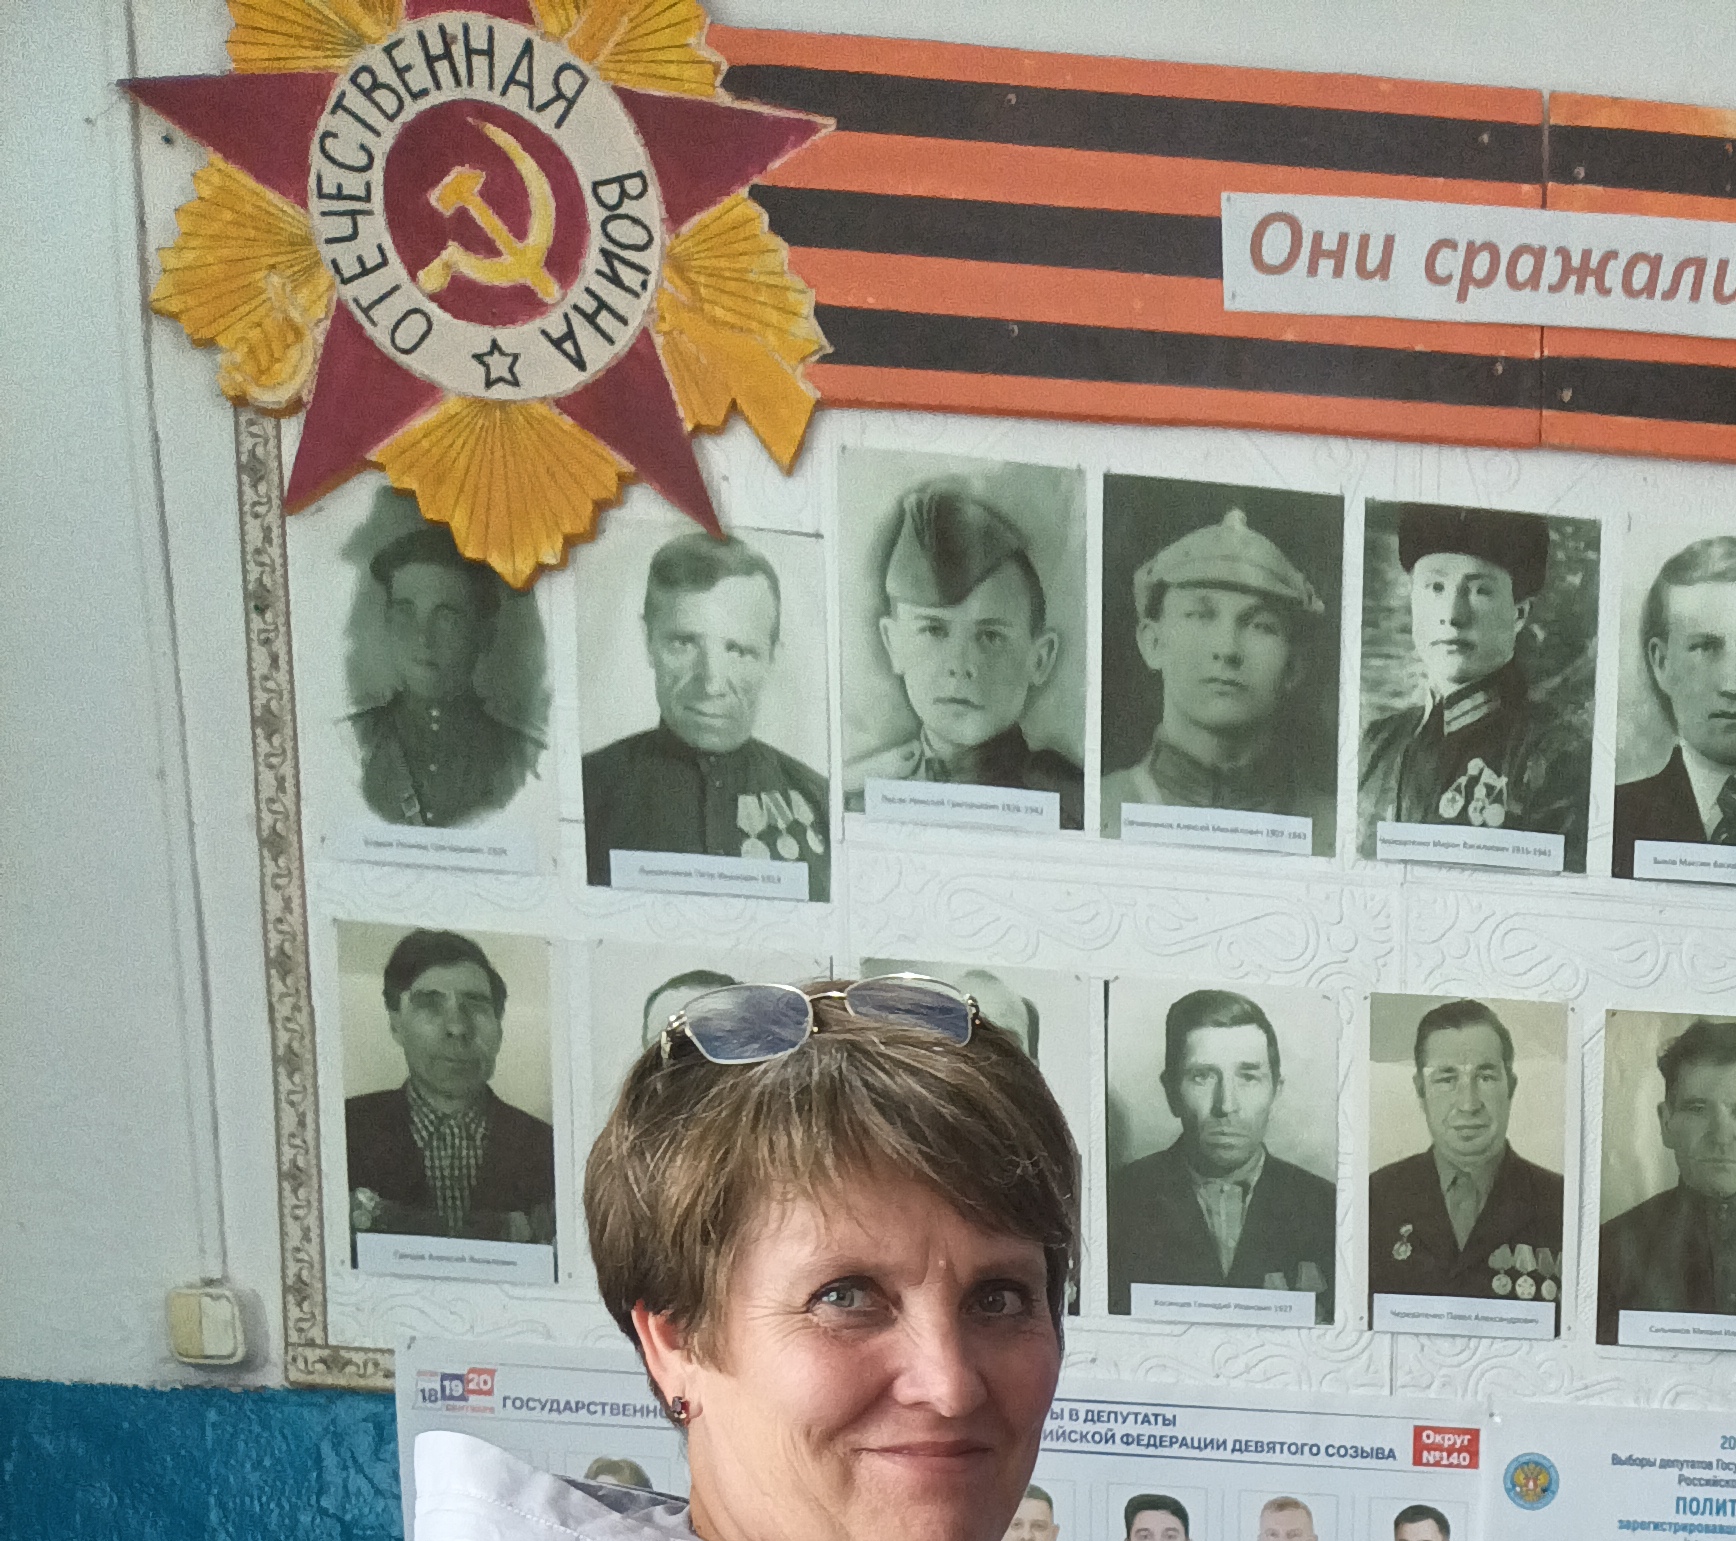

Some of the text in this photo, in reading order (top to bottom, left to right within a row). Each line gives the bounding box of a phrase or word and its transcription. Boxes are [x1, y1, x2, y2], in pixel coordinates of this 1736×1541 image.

[317, 22, 655, 373] ОТЕЧЕСТВЕННАЯ ВОЙНА
[1249, 211, 1396, 282] Они
[442, 1379, 463, 1397] 19
[467, 1373, 492, 1391] 20
[420, 1387, 439, 1403] 18
[1068, 1408, 1080, 1422] В
[1083, 1410, 1177, 1427] ДЕПУТАТЫ
[1043, 1425, 1397, 1461] ИЙСКОЙ ФЕДЕРАЦИИ ДЕВЯТОГО СОЗЫВА
[1421, 1429, 1471, 1448] Округ
[1720, 1435, 1736, 1450] 20
[1611, 1452, 1657, 1469] Выборы
